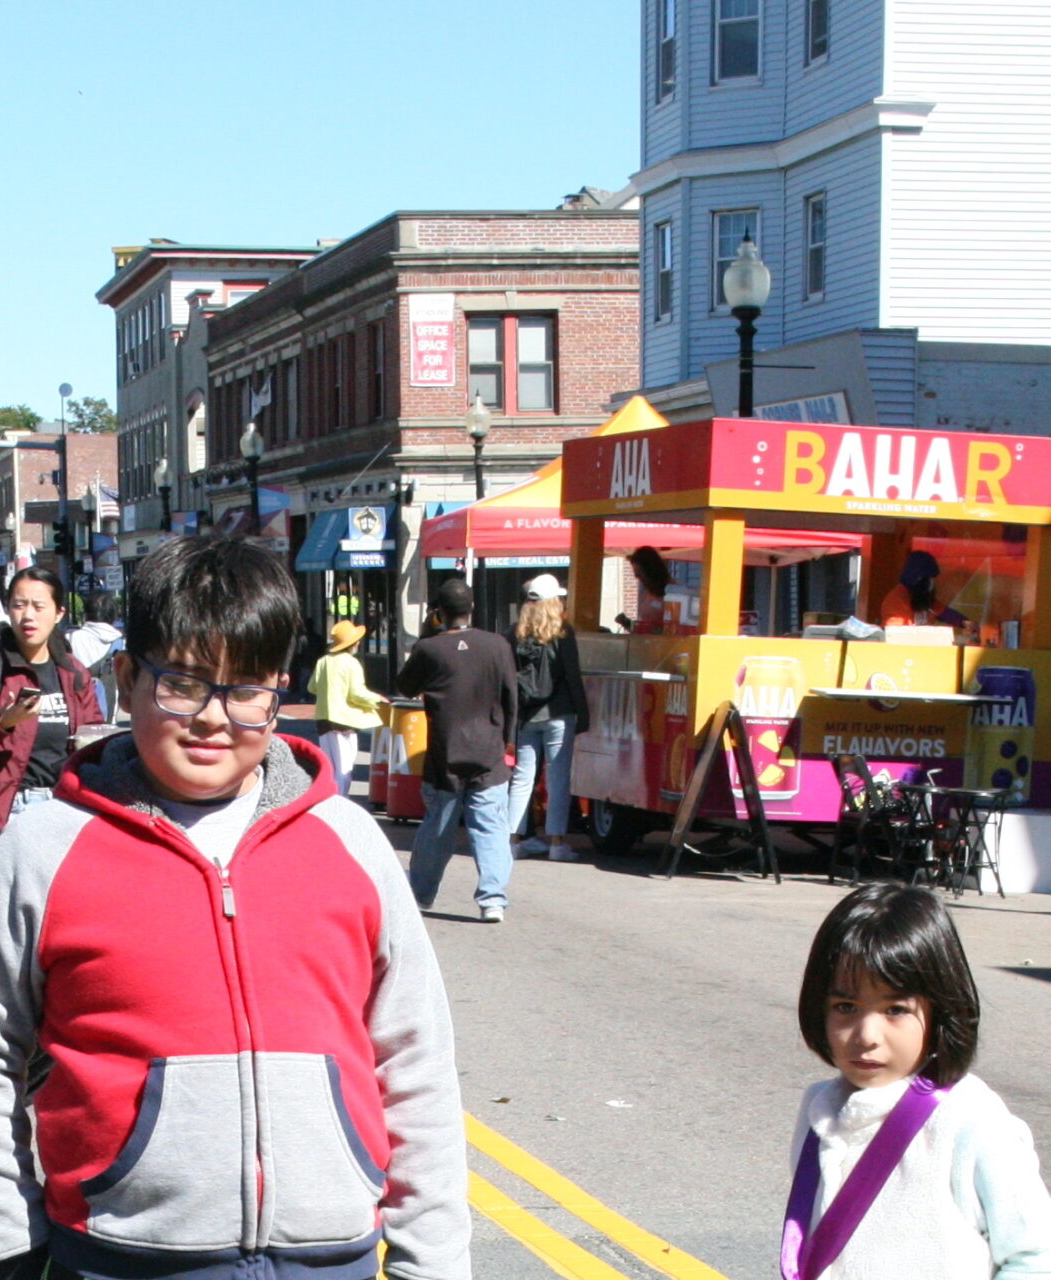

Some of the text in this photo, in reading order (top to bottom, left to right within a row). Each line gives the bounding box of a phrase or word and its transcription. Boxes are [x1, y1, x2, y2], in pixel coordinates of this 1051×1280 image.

[416, 325, 449, 336] OFFICE
[417, 340, 448, 351] SPACE
[423, 354, 443, 366] FOR
[417, 369, 448, 380] LEASE
[609, 437, 652, 499] AHA
[782, 429, 1012, 505] BAHAR
[845, 500, 937, 514] SPARKLING WATER
[504, 519, 515, 528] A
[739, 685, 796, 718] AHA
[972, 694, 1030, 727] AHA
[825, 722, 946, 735] MIX IT UP WITH NEW
[823, 735, 947, 758] FLAHAVORS
